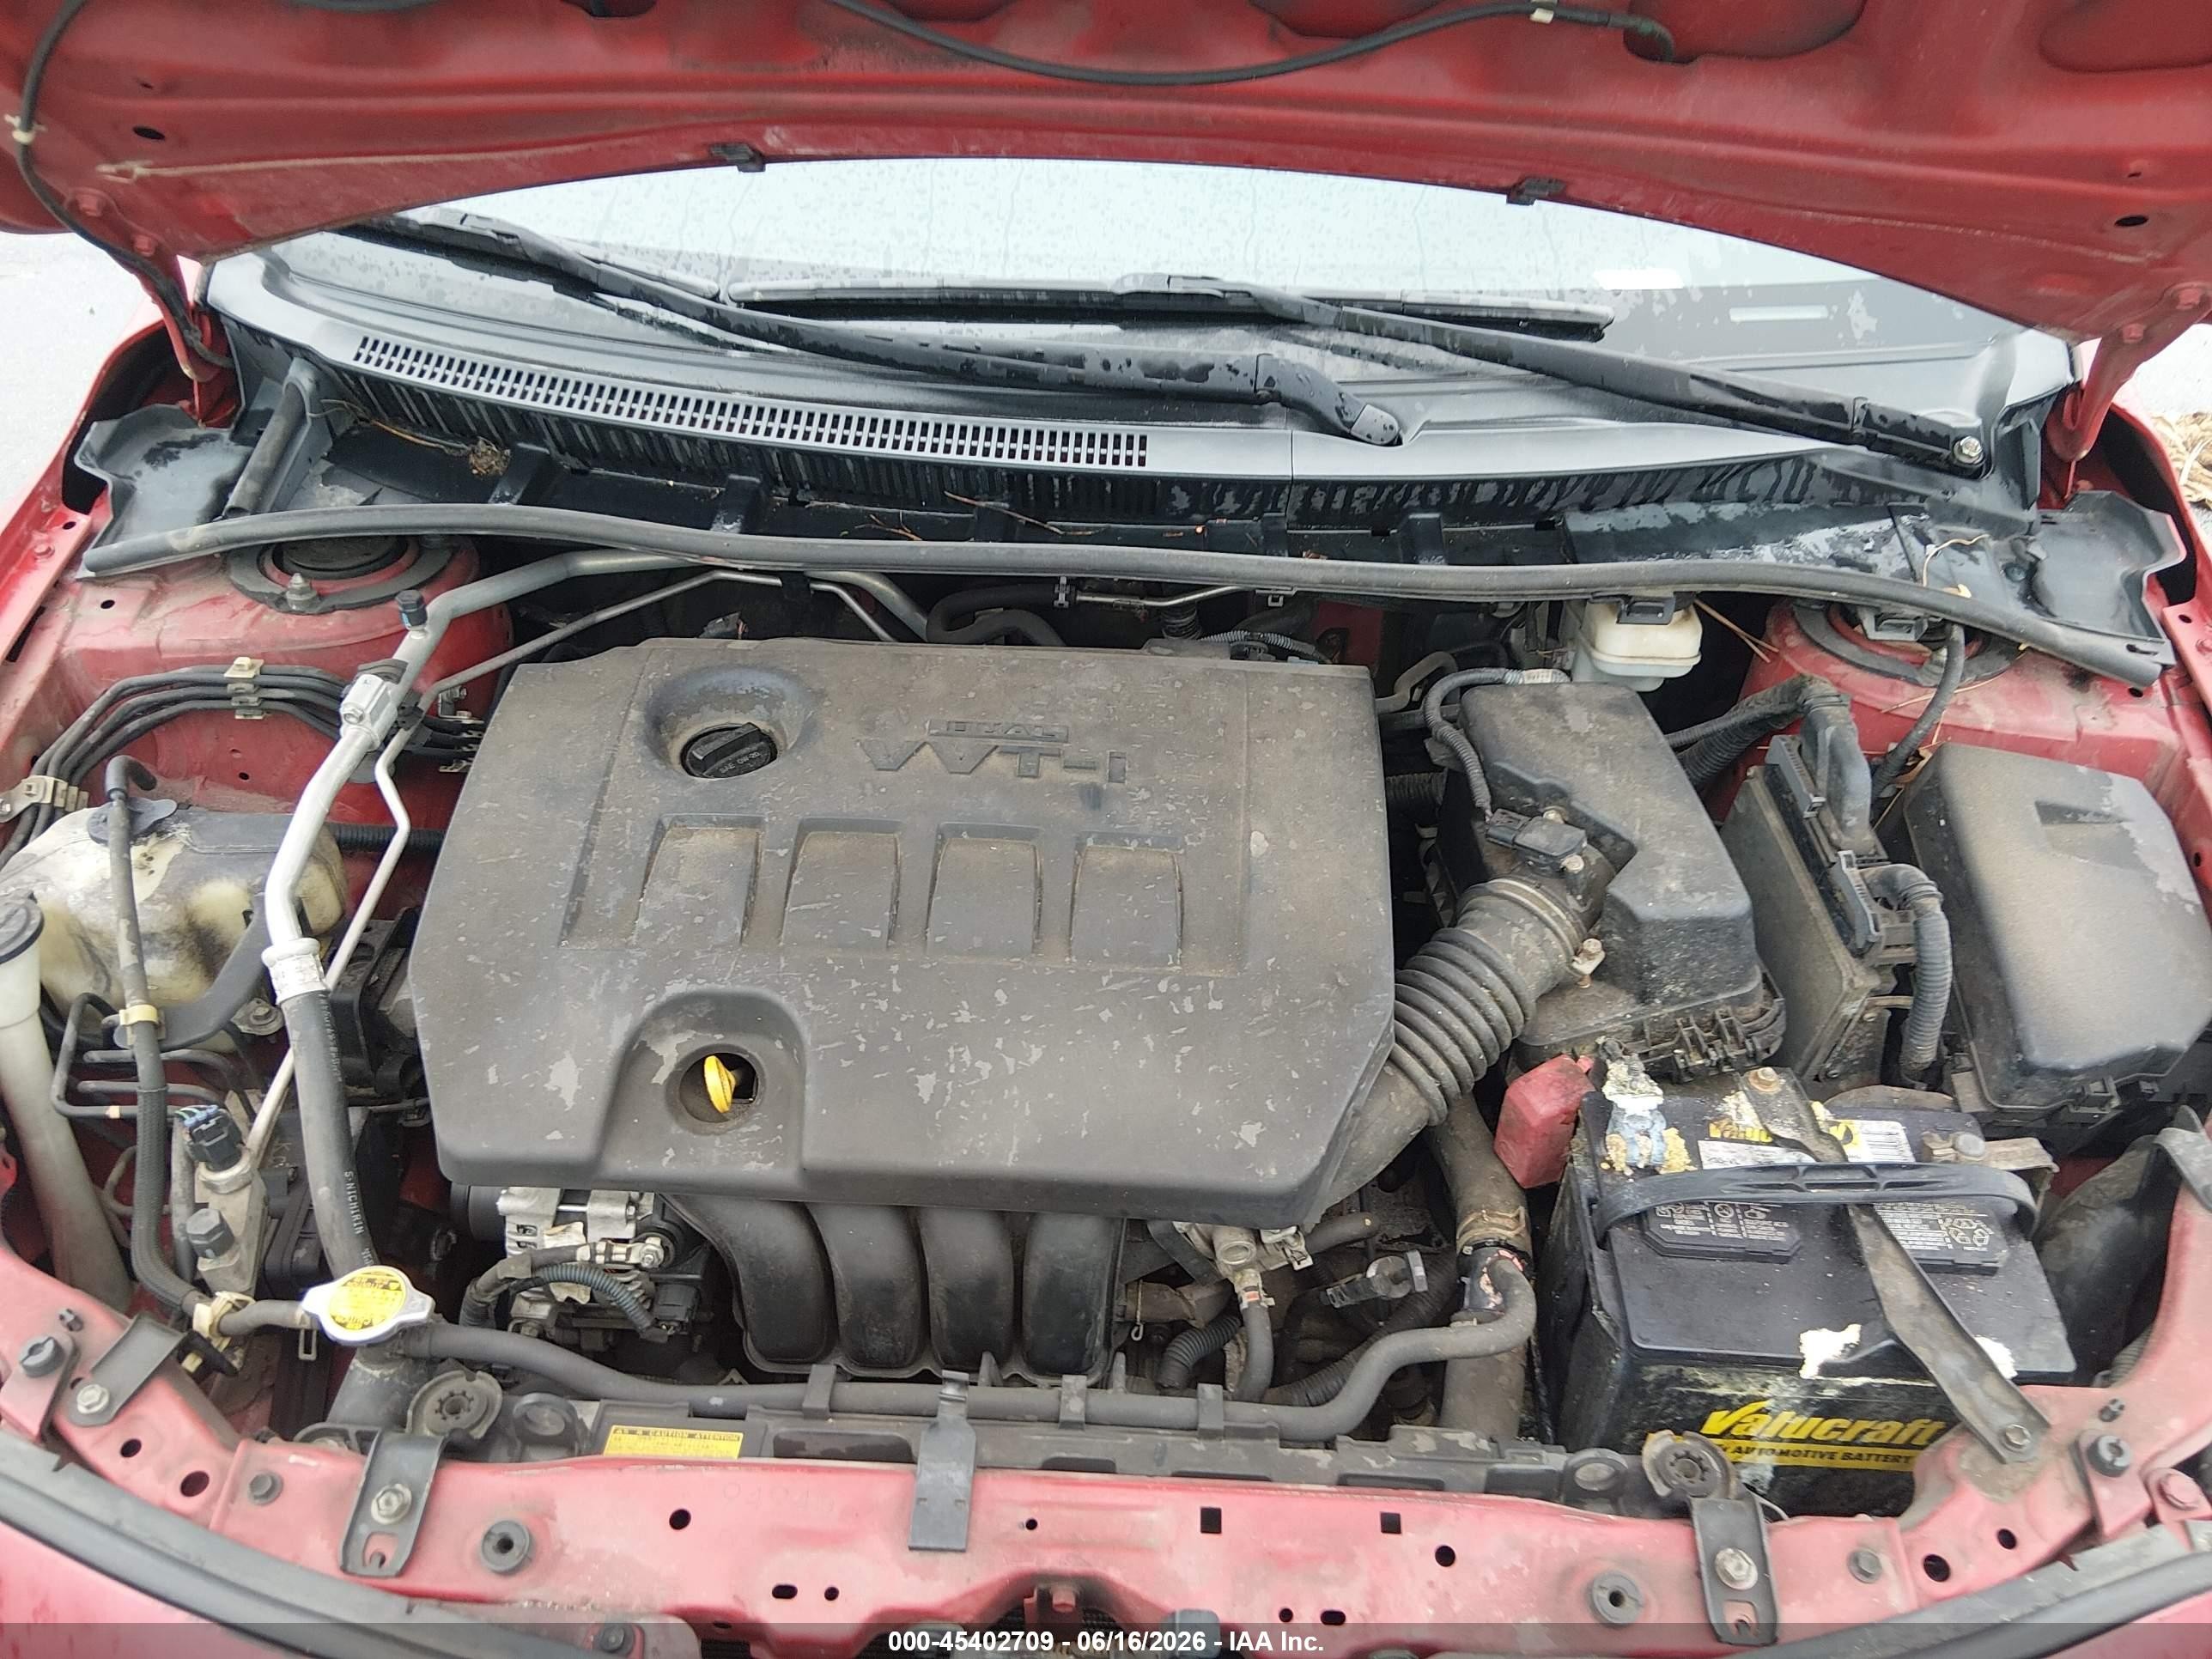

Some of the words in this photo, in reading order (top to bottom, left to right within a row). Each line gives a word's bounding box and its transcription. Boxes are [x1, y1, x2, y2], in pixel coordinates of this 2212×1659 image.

[720, 763, 736, 774] SAE
[1700, 1399, 1946, 1445] Valucraft
[1733, 1443, 1836, 1461] AUTOMOTIVE
[1840, 1451, 1911, 1464] BATTERY
